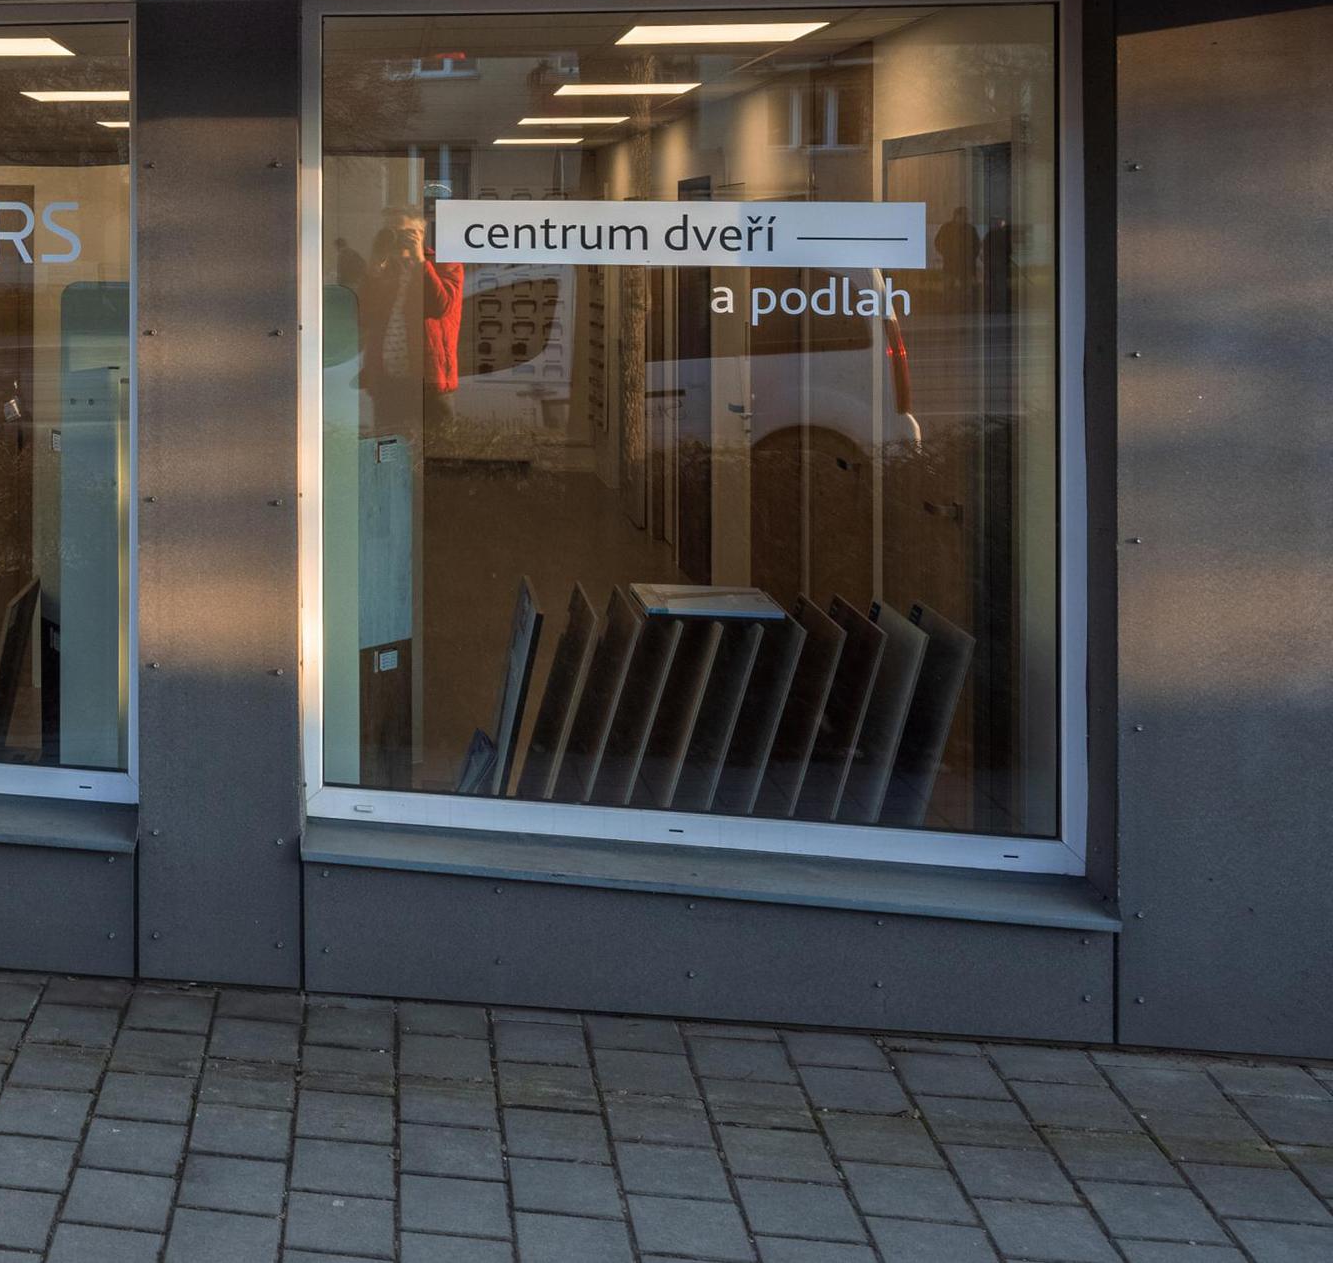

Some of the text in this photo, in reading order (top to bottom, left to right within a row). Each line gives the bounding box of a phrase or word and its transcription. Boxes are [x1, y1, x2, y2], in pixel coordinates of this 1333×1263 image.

[464, 213, 777, 252] centrum dveří
[710, 276, 911, 327] a podlah
